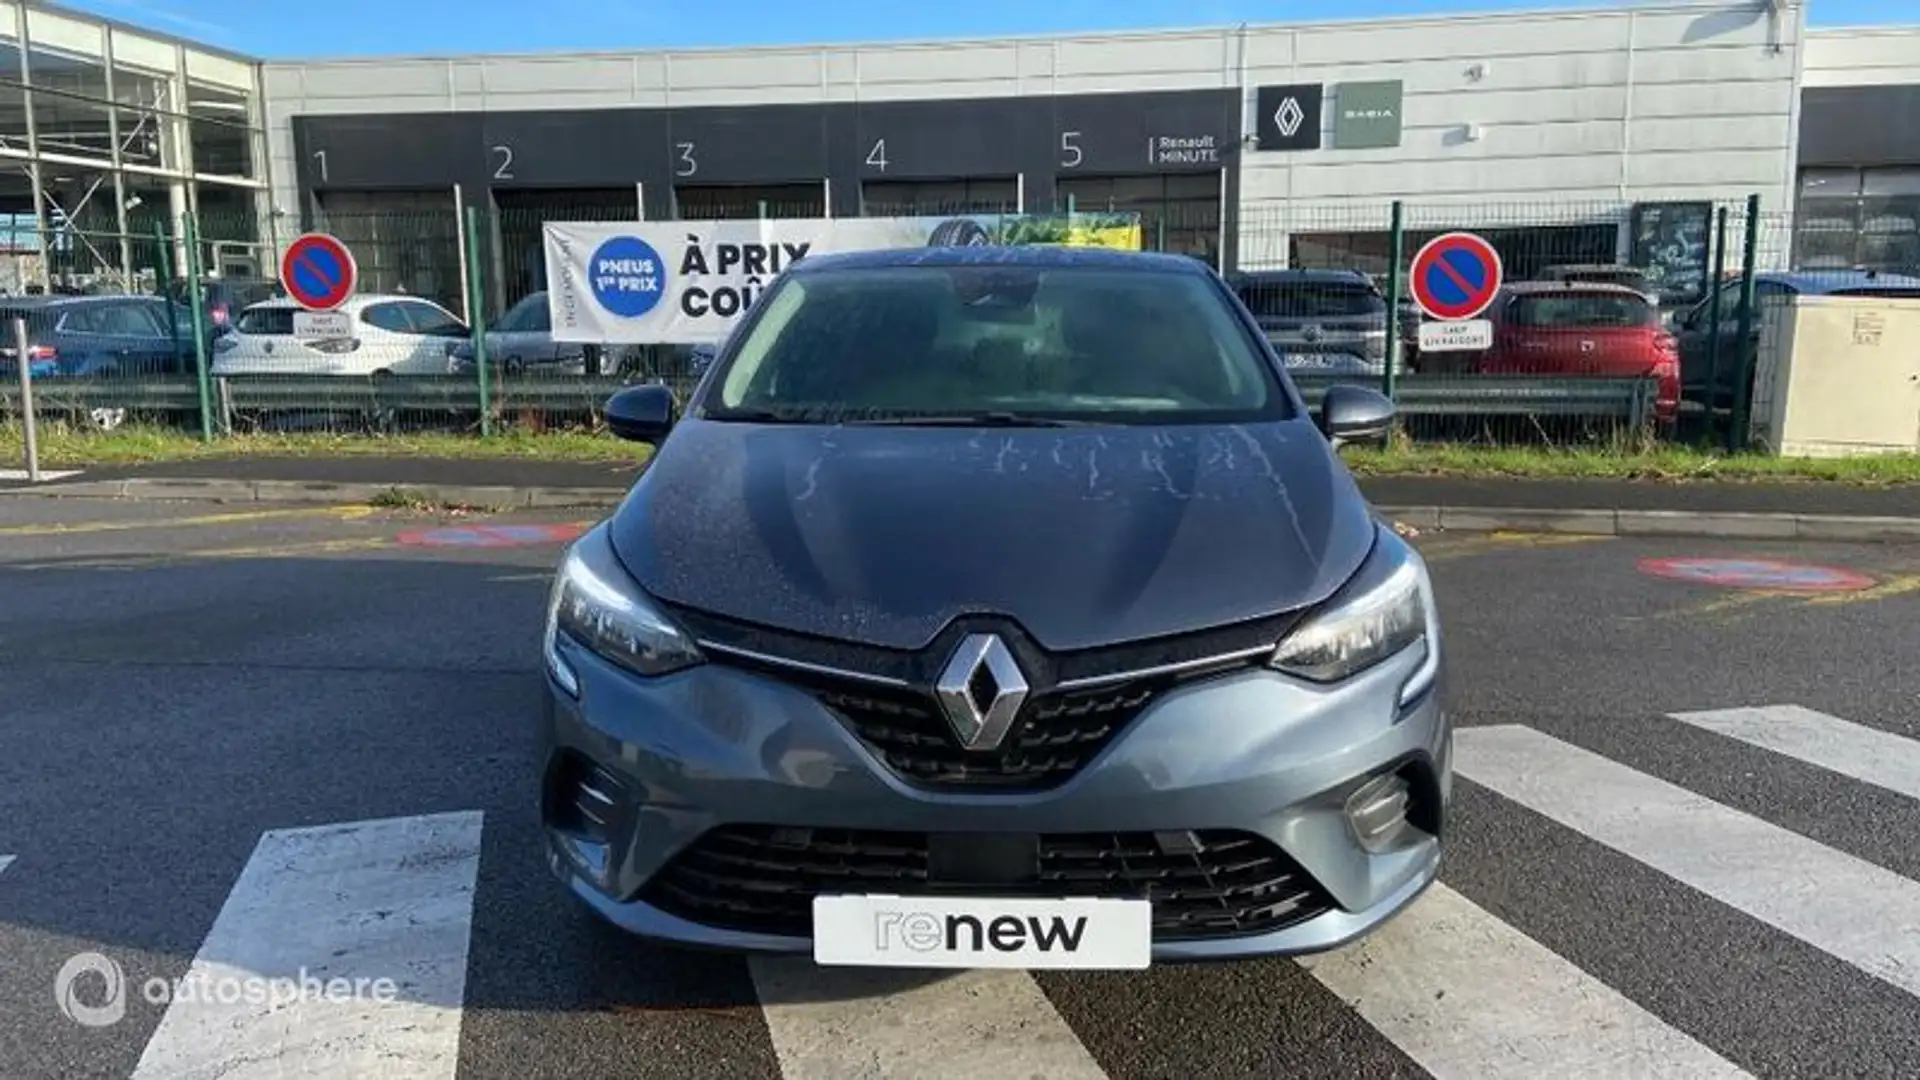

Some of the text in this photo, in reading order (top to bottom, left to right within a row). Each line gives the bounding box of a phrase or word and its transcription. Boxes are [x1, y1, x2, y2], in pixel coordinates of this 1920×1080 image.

[865, 138, 889, 173] 4
[1061, 131, 1083, 168] 5
[1158, 135, 1215, 148] Renault
[1158, 148, 1219, 164] MINUTE
[313, 150, 329, 182] 1
[492, 145, 515, 179] 2
[675, 142, 698, 177] 3
[598, 259, 655, 275] PNEUS
[680, 232, 710, 275] À
[619, 276, 658, 292] PRIX
[875, 911, 1088, 952] renew
